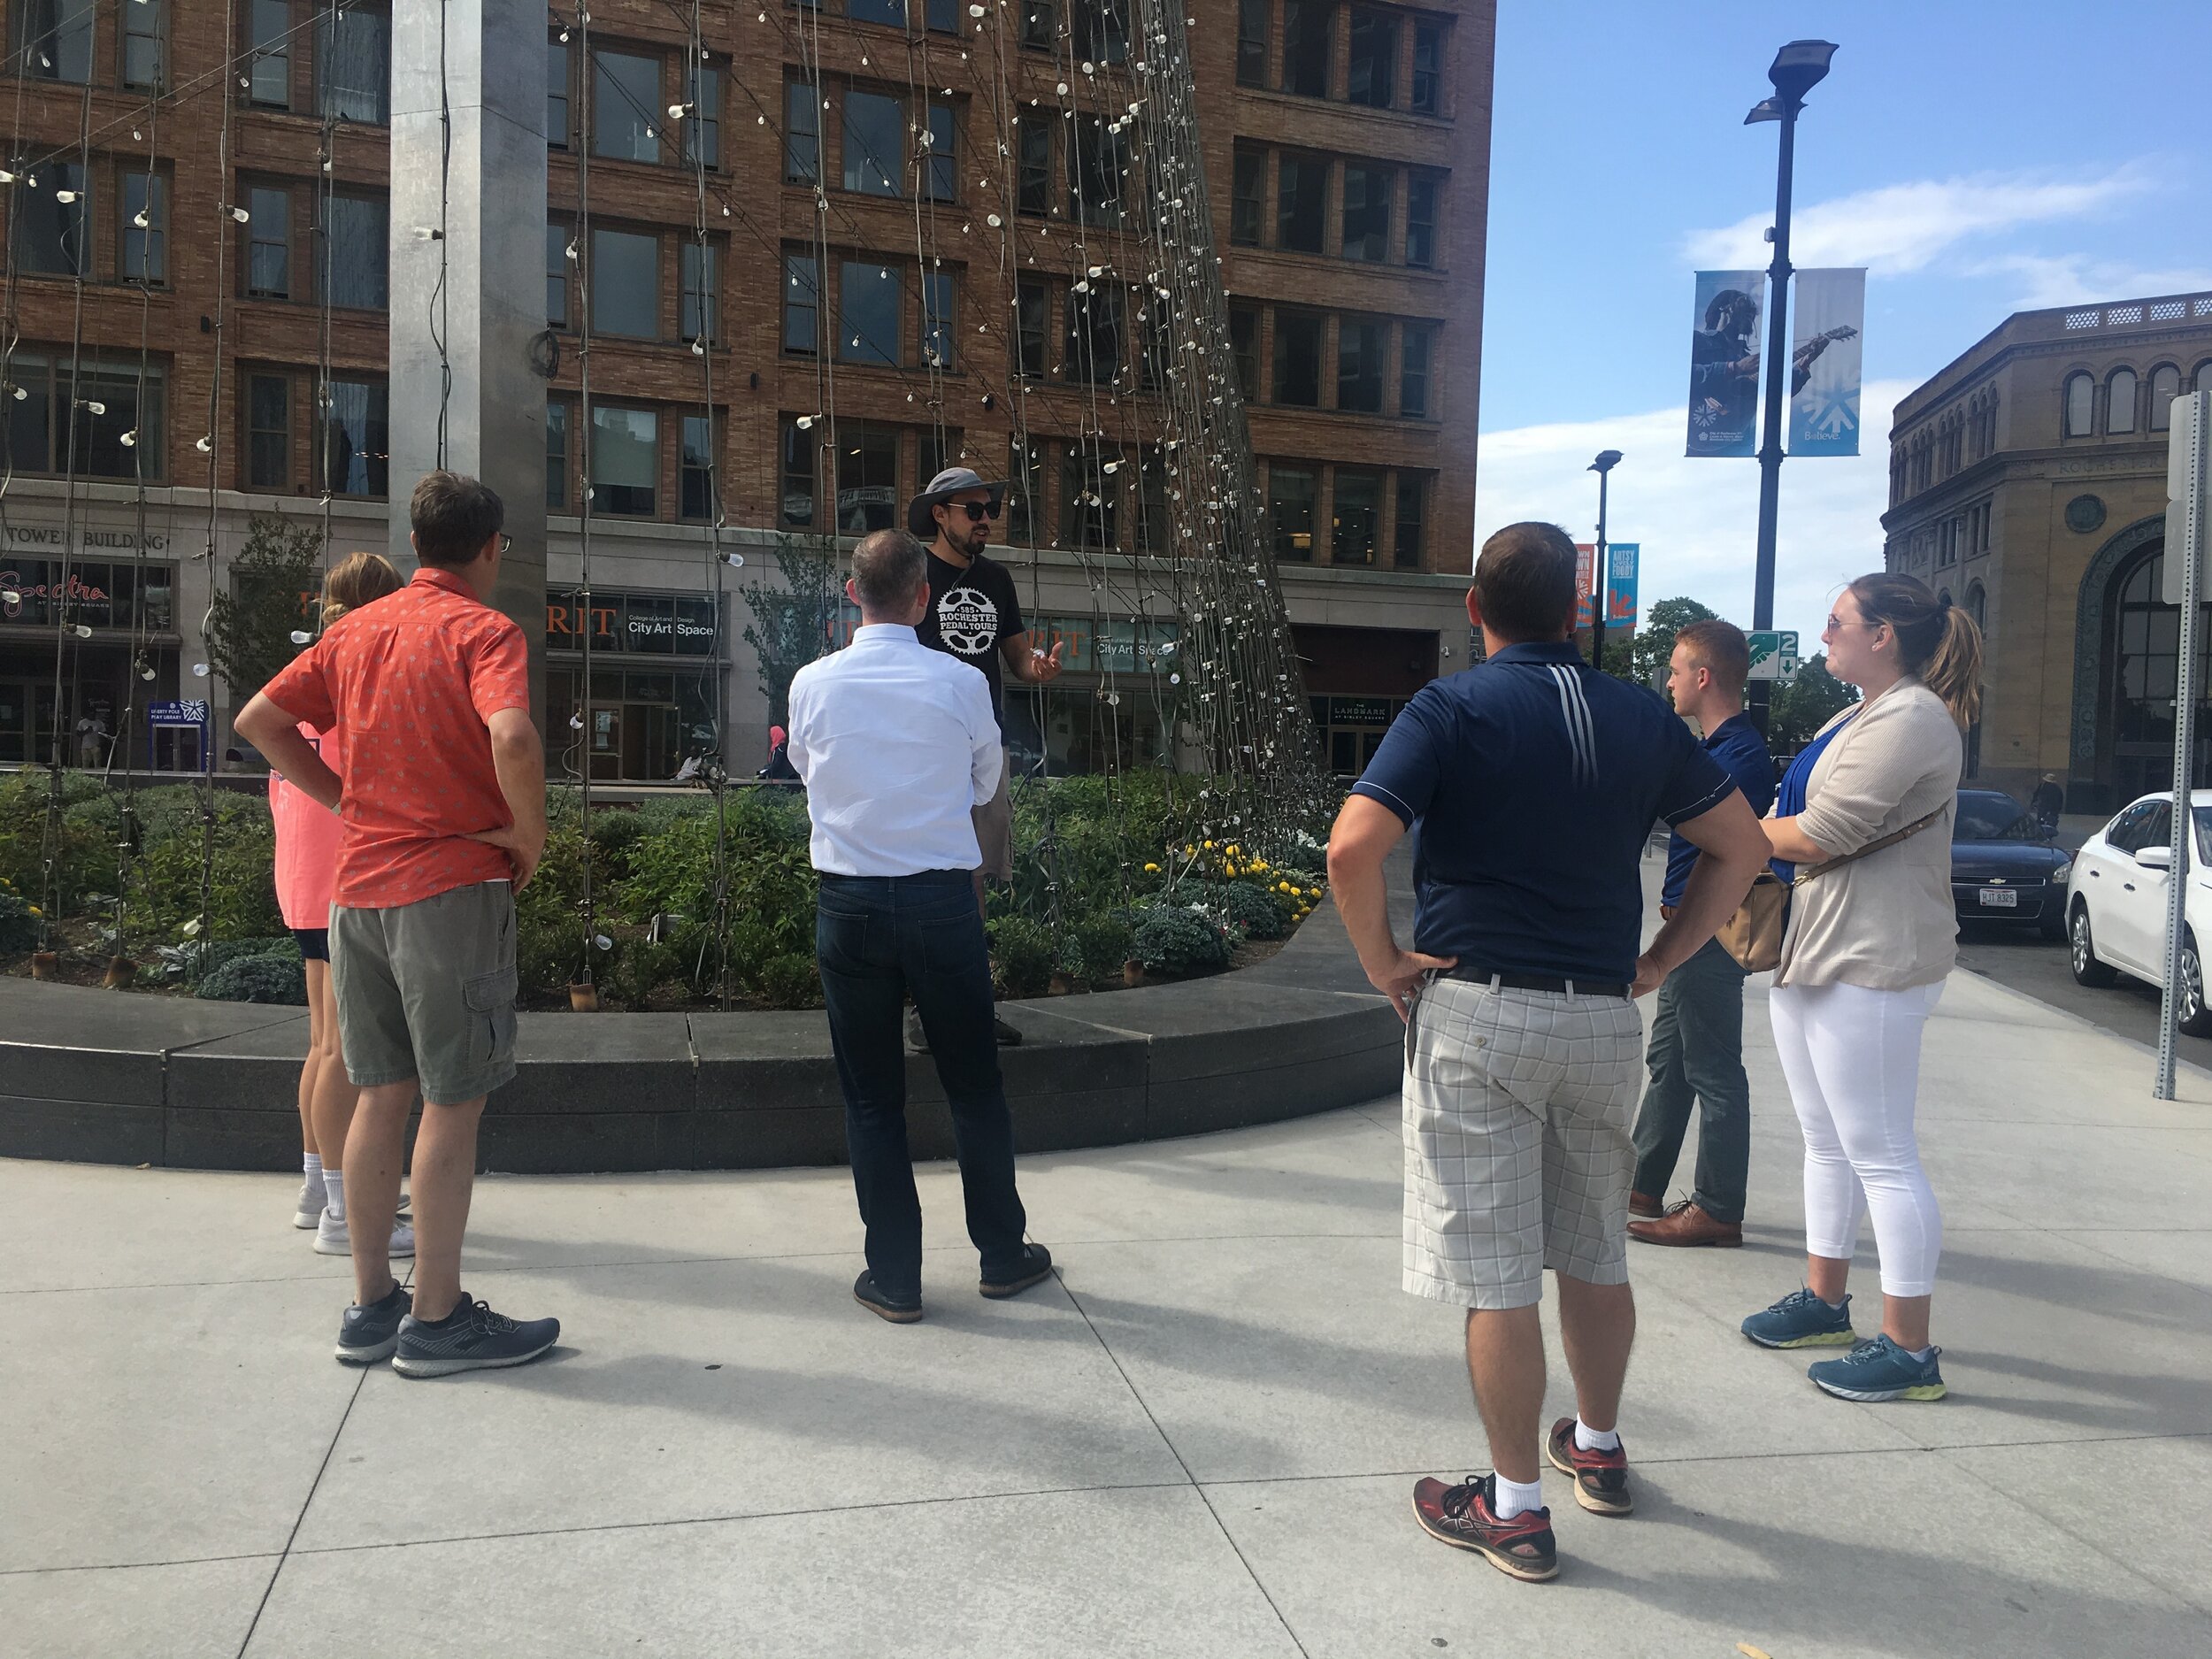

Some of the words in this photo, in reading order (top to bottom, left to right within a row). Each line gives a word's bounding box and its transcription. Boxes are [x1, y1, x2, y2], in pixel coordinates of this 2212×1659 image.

[546, 605, 616, 635] RIT
[939, 613, 998, 622] ROCHESTER
[628, 622, 651, 634] City
[654, 623, 672, 634] Art
[677, 624, 713, 636] Space
[1118, 644, 1133, 655] Art
[1781, 634, 1796, 652] 2
